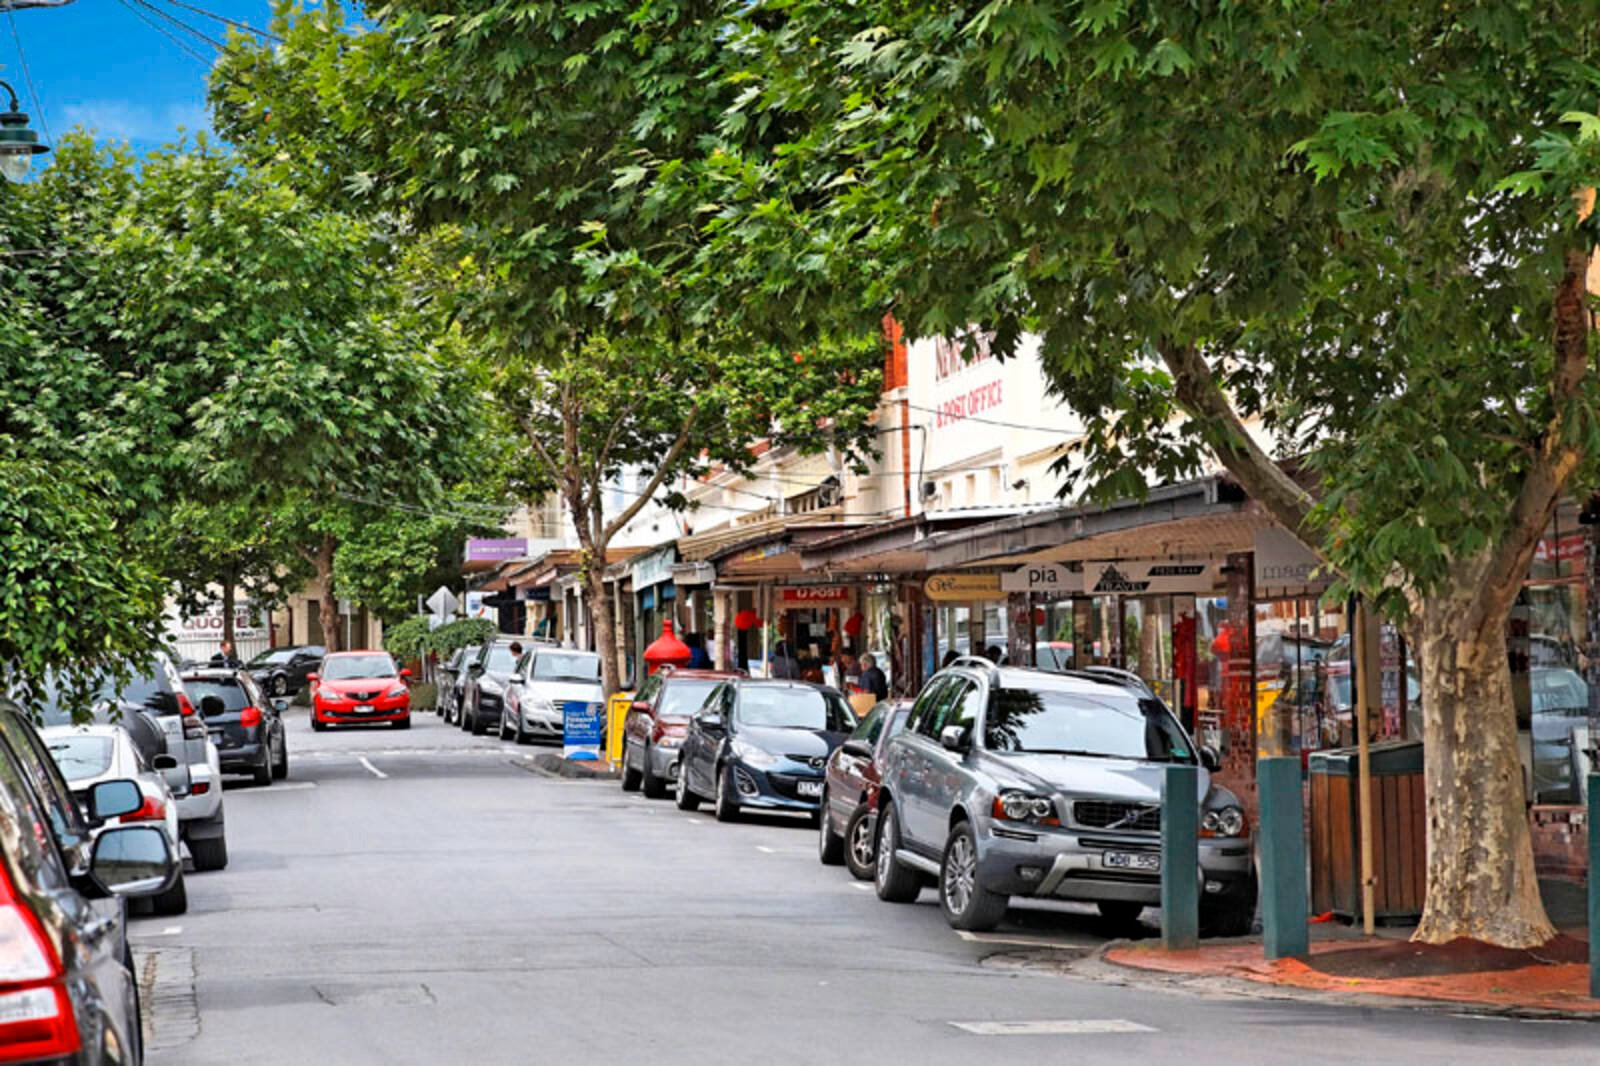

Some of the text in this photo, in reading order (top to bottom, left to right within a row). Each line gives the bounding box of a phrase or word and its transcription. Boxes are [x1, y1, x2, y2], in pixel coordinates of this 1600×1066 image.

[943, 395, 967, 425] POST
[967, 379, 1003, 416] OFFICE
[1028, 565, 1057, 586] pia
[810, 586, 842, 598] POST
